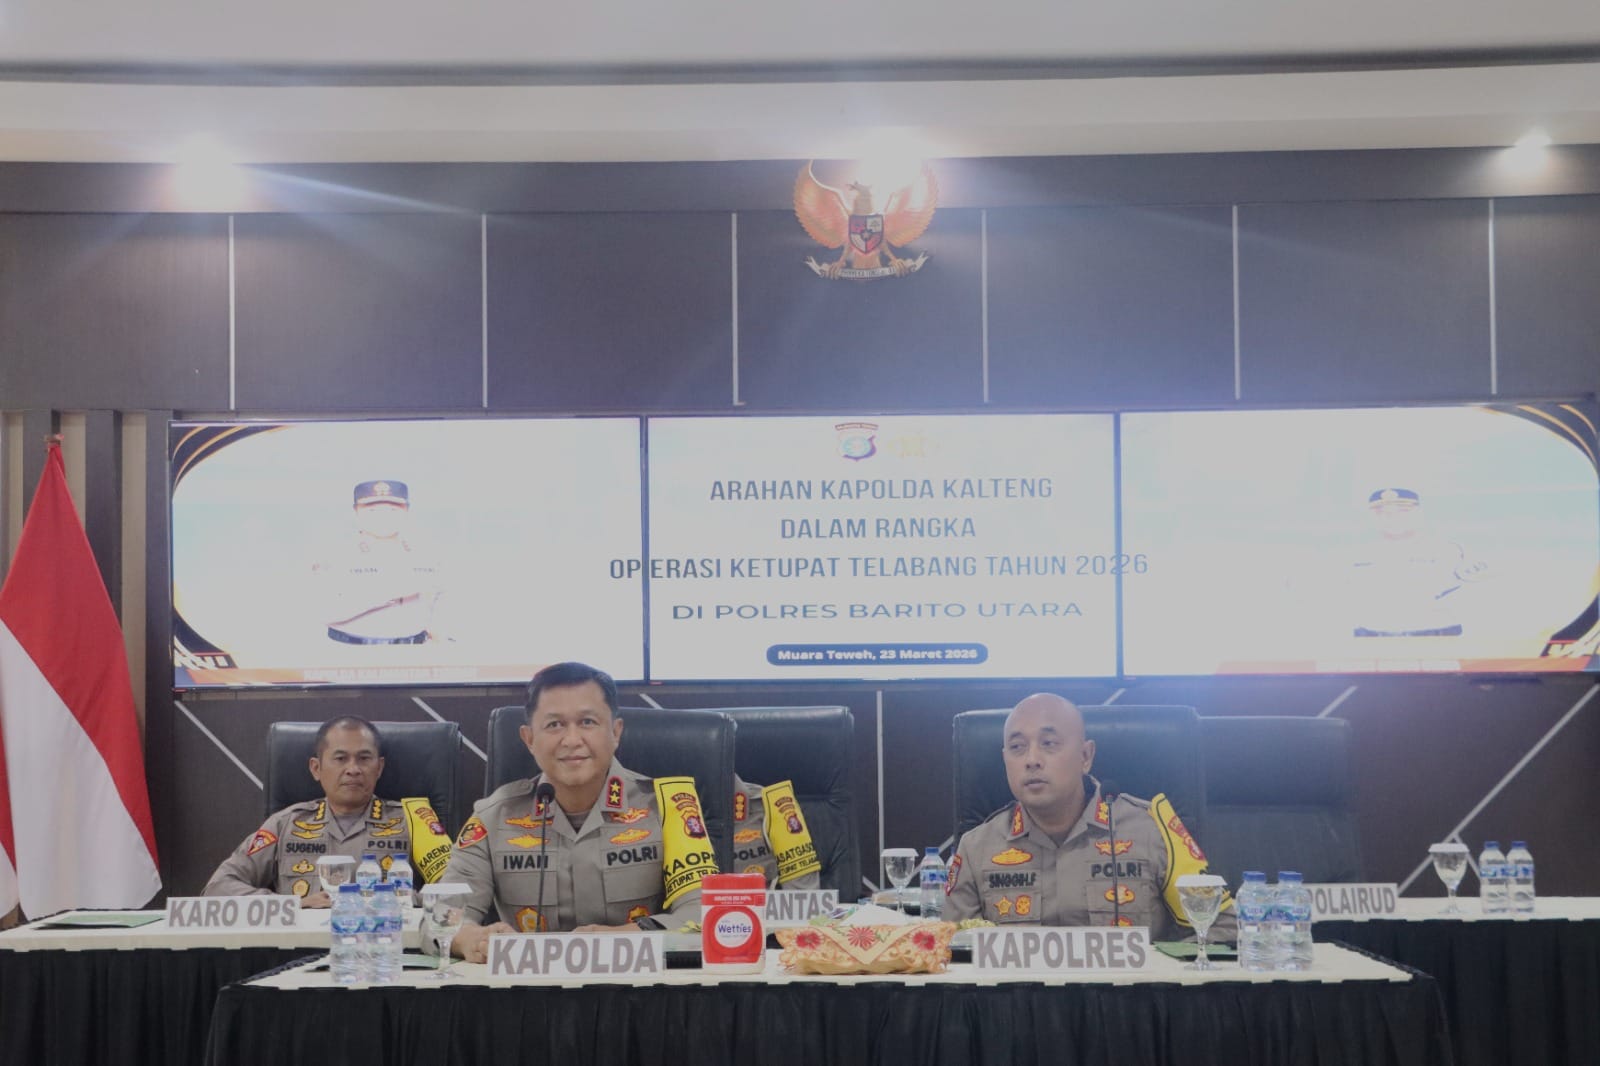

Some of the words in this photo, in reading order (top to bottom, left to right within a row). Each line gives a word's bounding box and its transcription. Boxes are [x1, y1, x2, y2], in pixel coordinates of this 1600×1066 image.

[710, 480, 812, 500] ARAHAN
[821, 479, 934, 499] KAPOLDA
[943, 478, 1052, 498] KALTENG
[781, 518, 867, 539] DALAM
[875, 517, 976, 538] RANGKA
[610, 559, 721, 578] OPERASI
[730, 557, 840, 578] KETUPAT
[848, 556, 977, 577] TELABANG
[985, 555, 1066, 576] TAHUN
[672, 605, 703, 619] DI
[715, 604, 838, 619] POLRES
[849, 603, 966, 618] BARITO
[978, 602, 1083, 617] UTARA
[778, 650, 823, 660] Muara
[880, 649, 896, 659] 23
[900, 649, 942, 659] Maret
[285, 842, 326, 854] SUGENG
[367, 840, 408, 851] POLRI
[606, 845, 658, 867] POLRI
[1091, 862, 1142, 877] POLRI
[169, 899, 239, 928] KARO
[247, 899, 296, 926] OPS
[718, 923, 752, 934] Wetties
[491, 937, 657, 975] KAPOLDA
[978, 931, 1146, 968] KAPOLRES
